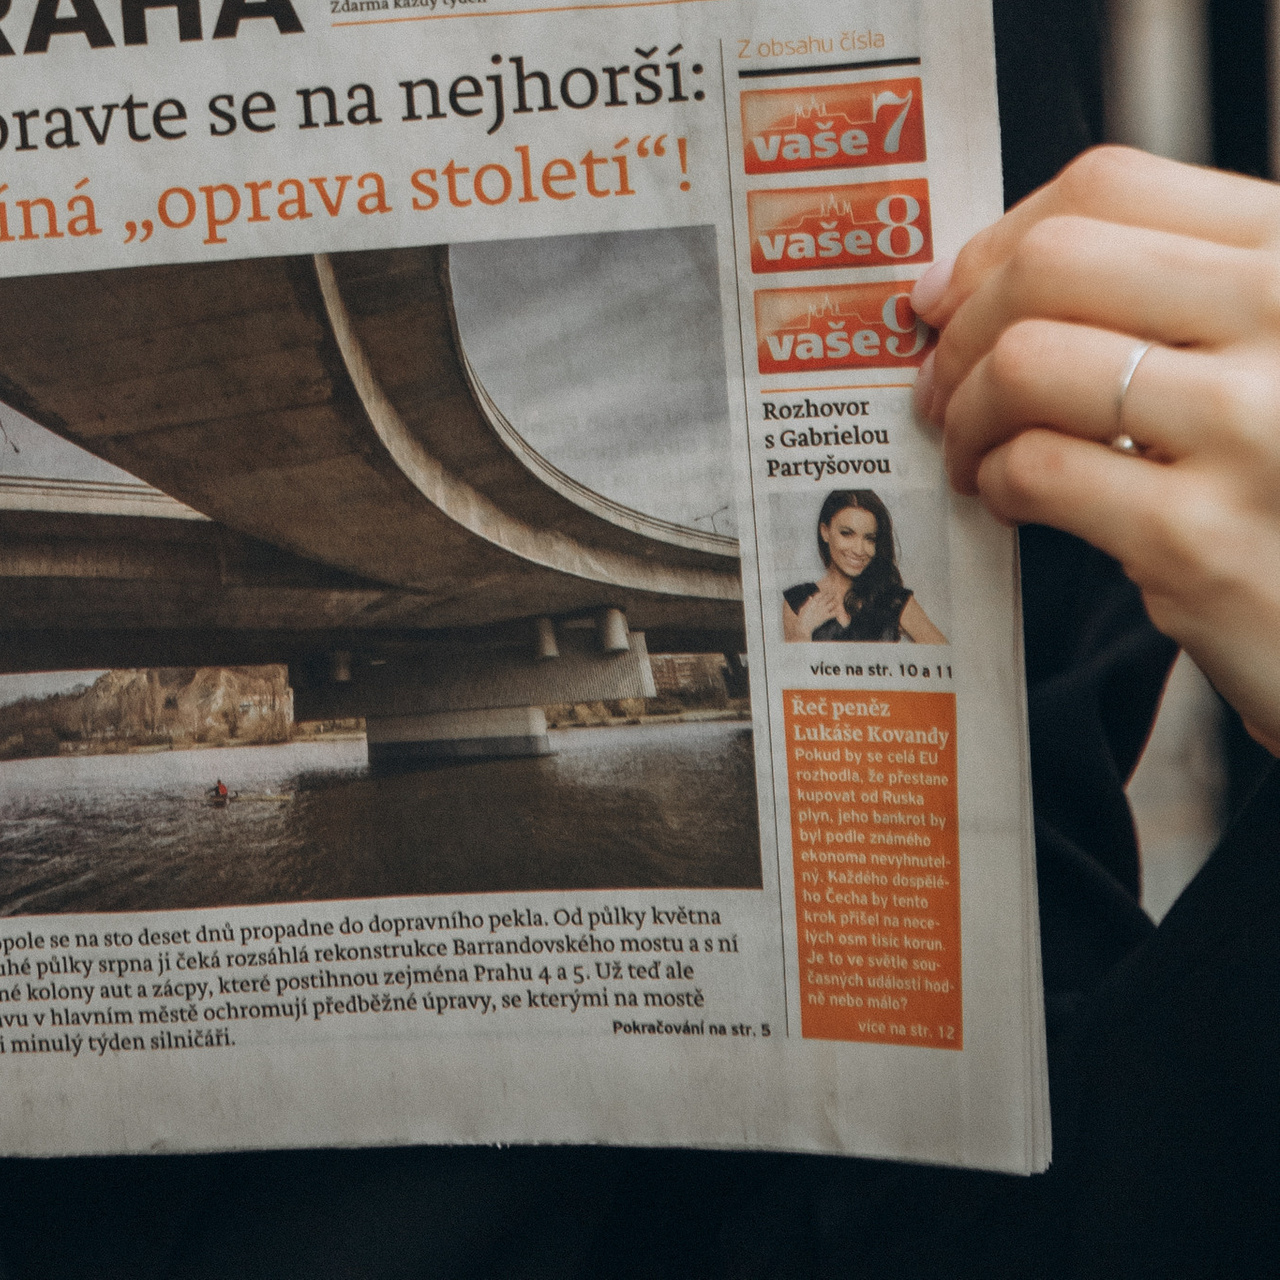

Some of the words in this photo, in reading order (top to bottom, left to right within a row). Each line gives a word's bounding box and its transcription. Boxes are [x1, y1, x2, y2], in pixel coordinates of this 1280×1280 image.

[738, 39, 752, 59] Z
[758, 36, 834, 56] obsahu
[840, 30, 886, 51] čísla
[209, 91, 276, 136] se
[296, 83, 382, 129] na
[399, 44, 704, 134] nejhorší:
[753, 121, 869, 162] vaše
[872, 90, 913, 153] 7
[124, 173, 392, 244] „oprava
[411, 135, 691, 210] století“!
[756, 221, 872, 260] vaše
[875, 194, 924, 258] 8
[766, 321, 880, 361] vaše
[763, 399, 869, 420] Rozhovor
[780, 425, 889, 447] Gabrielou
[767, 455, 890, 481] Partyšovou
[792, 696, 827, 715] Řeč
[832, 698, 890, 719] peněz
[867, 726, 948, 750] Kovandy
[196, 923, 234, 942] dnů
[240, 919, 334, 946] propadne
[369, 911, 484, 937] dopravního
[489, 908, 548, 933] pekla.
[554, 907, 583, 926] Od
[588, 906, 646, 931] půlky
[36, 956, 93, 978] půlky
[158, 952, 170, 973] ji
[176, 951, 220, 970] čeká
[226, 942, 309, 967] rozsáhlá
[315, 939, 447, 962] rekonstrukce
[453, 935, 615, 955] Barrandovského
[761, 1024, 771, 1037] 5
